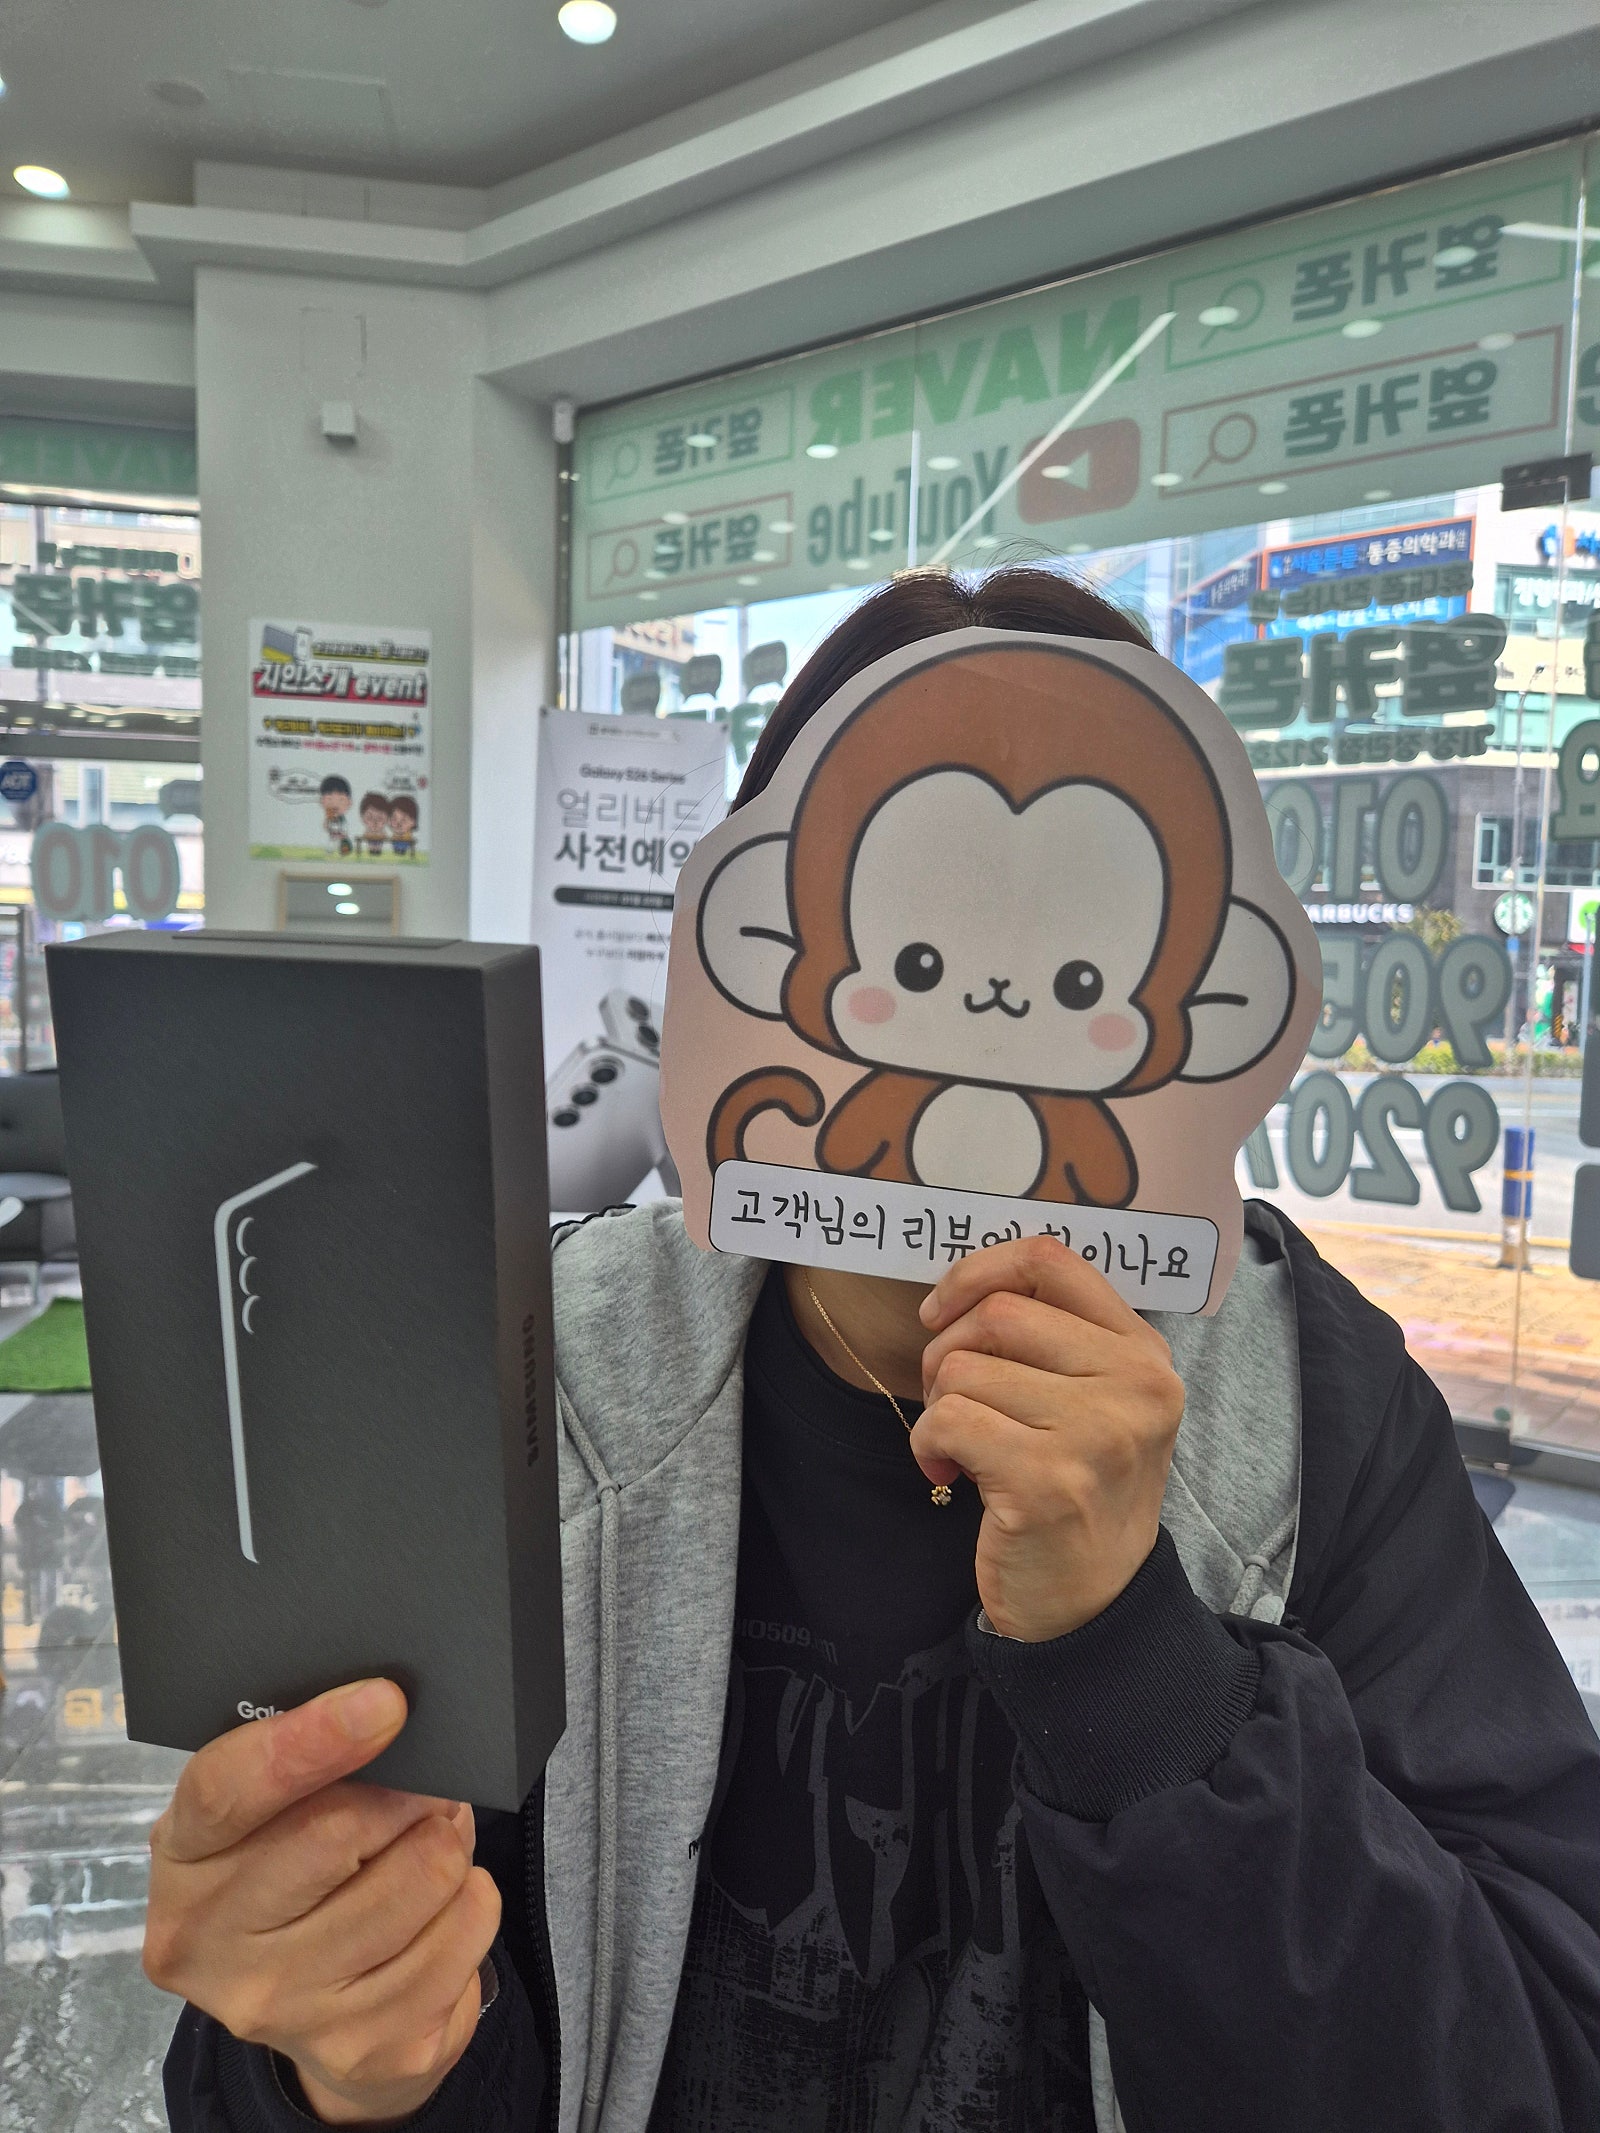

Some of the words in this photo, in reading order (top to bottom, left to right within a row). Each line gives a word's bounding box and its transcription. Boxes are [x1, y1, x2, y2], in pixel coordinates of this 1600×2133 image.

[257, 661, 352, 697] 지인소개
[355, 671, 425, 702] event
[579, 763, 625, 783] Galaxy
[651, 768, 686, 785] Series
[557, 787, 701, 832] 얼리버드
[1303, 902, 1414, 924] ARBUCKS
[731, 1189, 886, 1250] 고객님의
[236, 1700, 285, 1720] Gal
